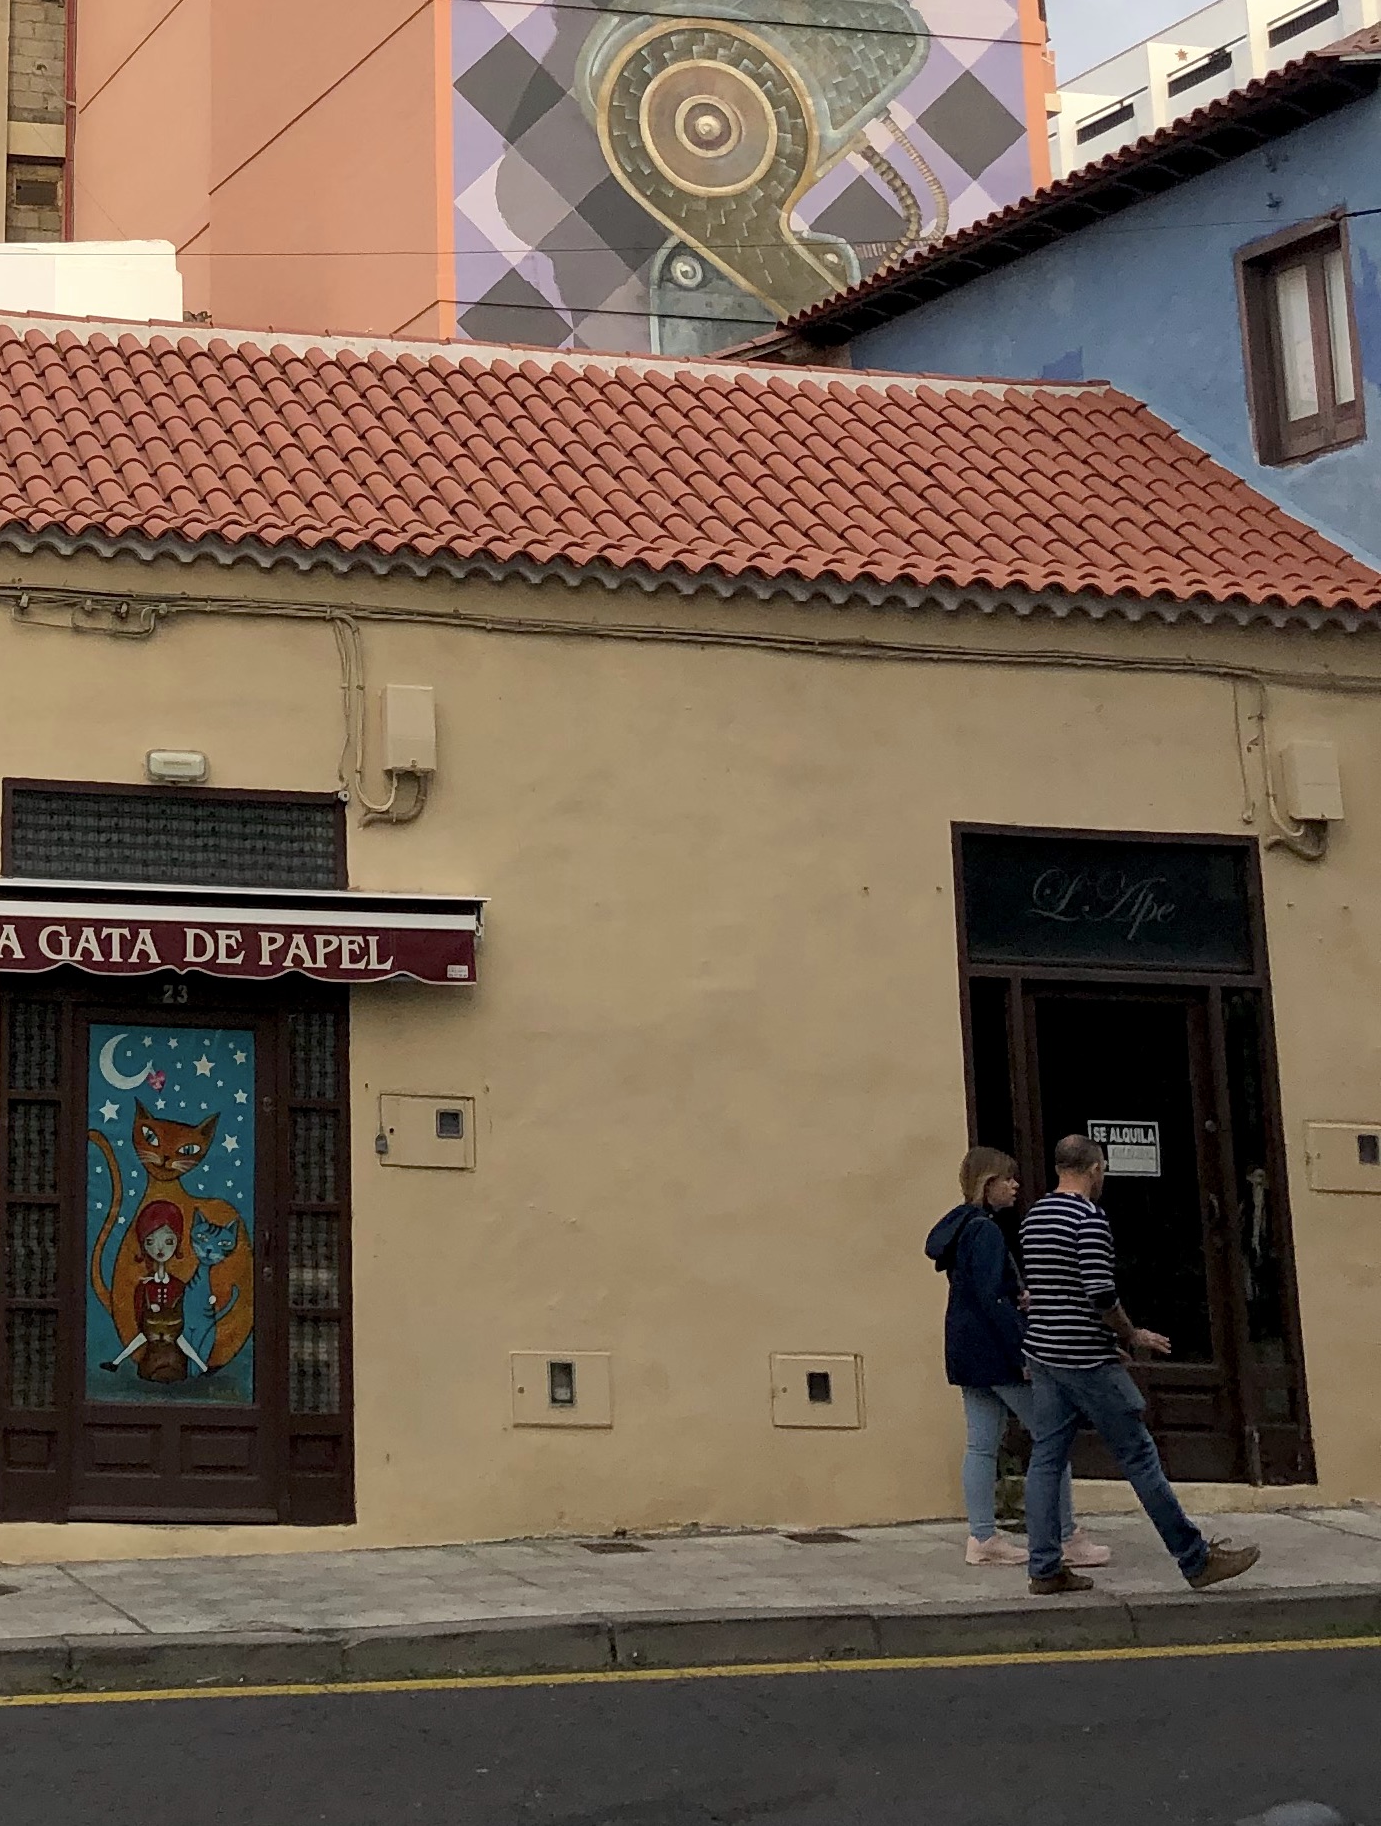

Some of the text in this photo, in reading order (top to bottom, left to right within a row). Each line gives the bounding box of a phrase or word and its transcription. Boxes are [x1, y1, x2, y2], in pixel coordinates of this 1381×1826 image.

[38, 924, 162, 964] GATA
[183, 927, 246, 965] DE
[258, 931, 394, 971] PAPEL
[163, 984, 189, 1005] 23
[1093, 1126, 1156, 1144] SE ALQUILA
